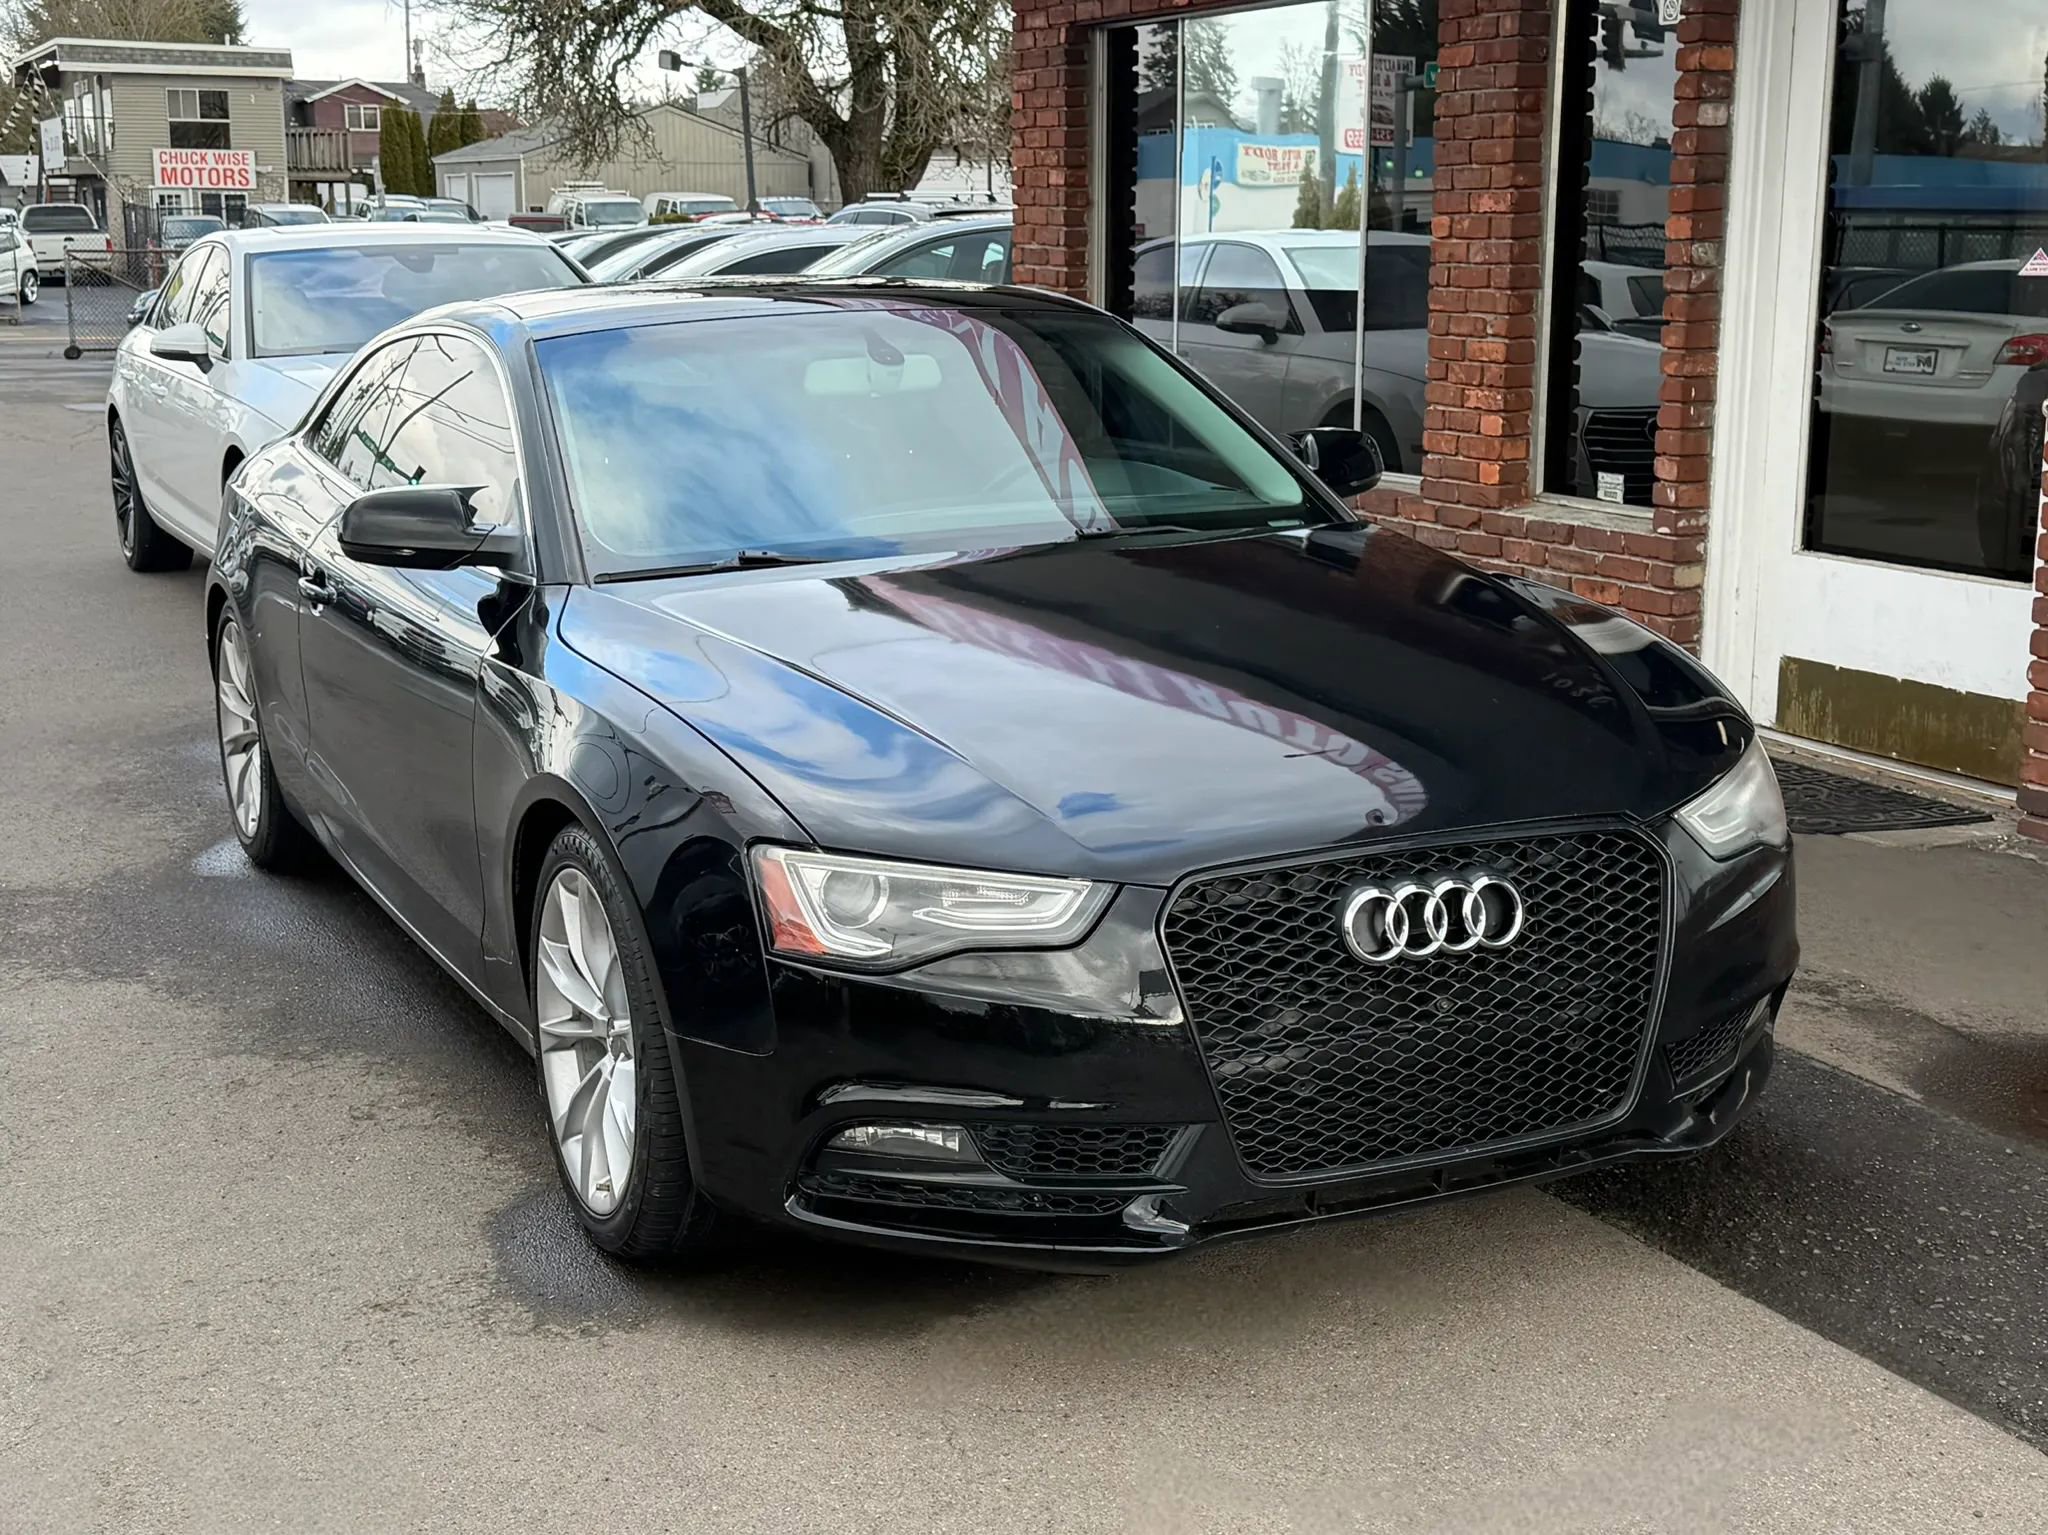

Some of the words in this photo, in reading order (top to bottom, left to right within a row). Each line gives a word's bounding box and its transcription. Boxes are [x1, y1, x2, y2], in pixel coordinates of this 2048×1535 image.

[159, 150, 209, 166] CHUCK
[213, 152, 250, 166] WISE
[160, 166, 250, 187] MOTORS
